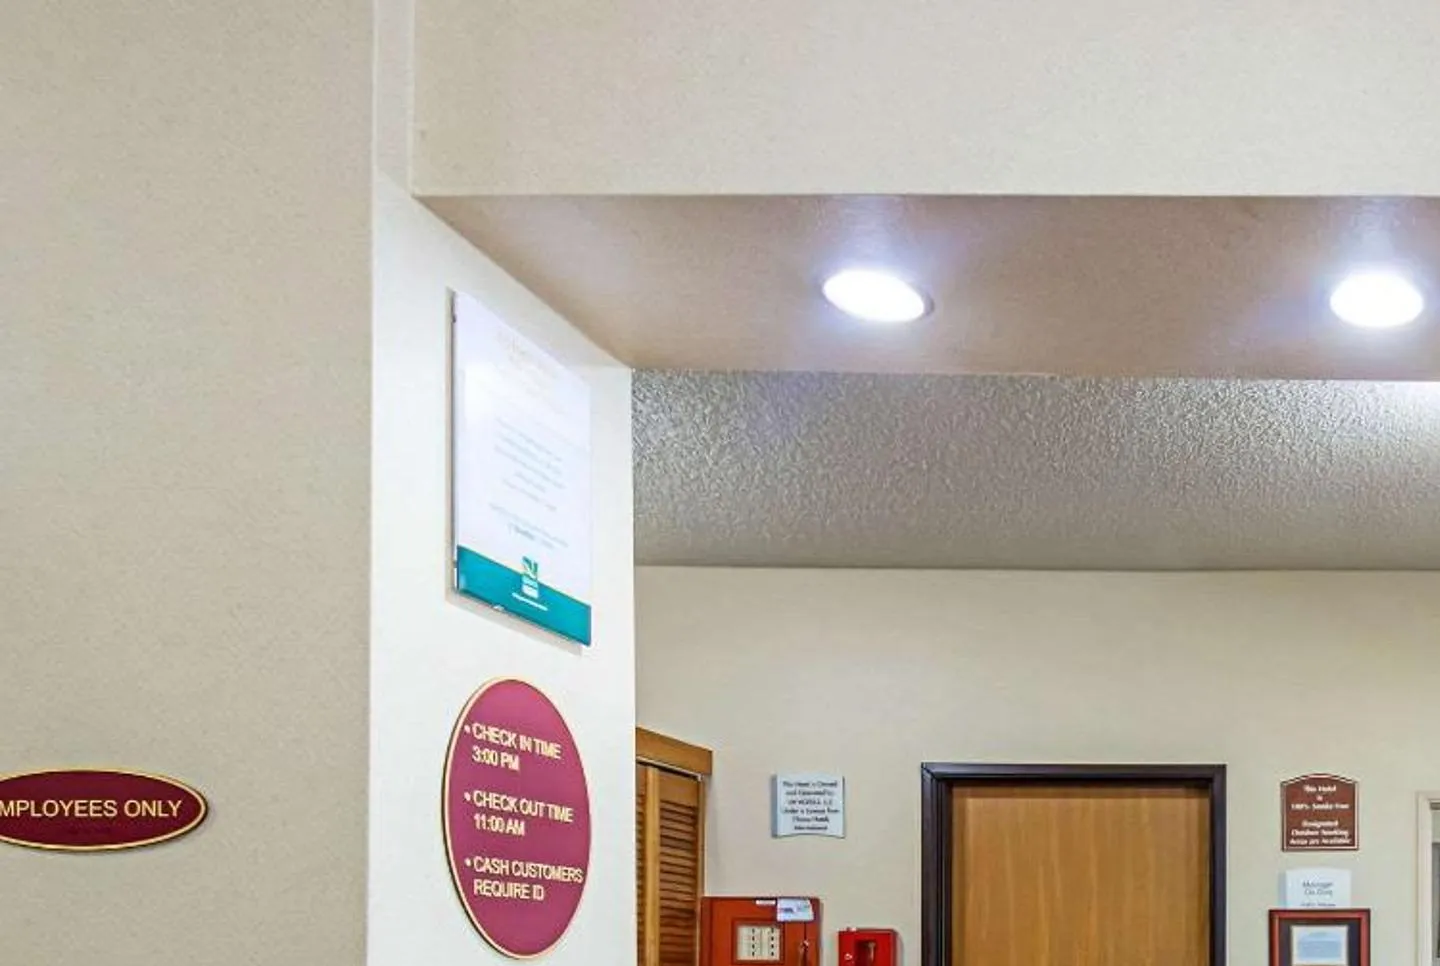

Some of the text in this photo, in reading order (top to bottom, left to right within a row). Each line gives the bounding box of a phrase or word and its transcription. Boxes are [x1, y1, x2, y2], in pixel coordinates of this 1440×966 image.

[472, 722, 563, 760] CHECK IN TIME
[472, 745, 520, 771] 3:00 PM
[0, 800, 182, 817] MPLOYEES ONLY
[473, 790, 574, 823] CHECK OUT TIME
[474, 813, 525, 836] 11:00 AM
[474, 856, 584, 883] CASH CUSTOMERS
[473, 879, 545, 901] REQUIRE ID
